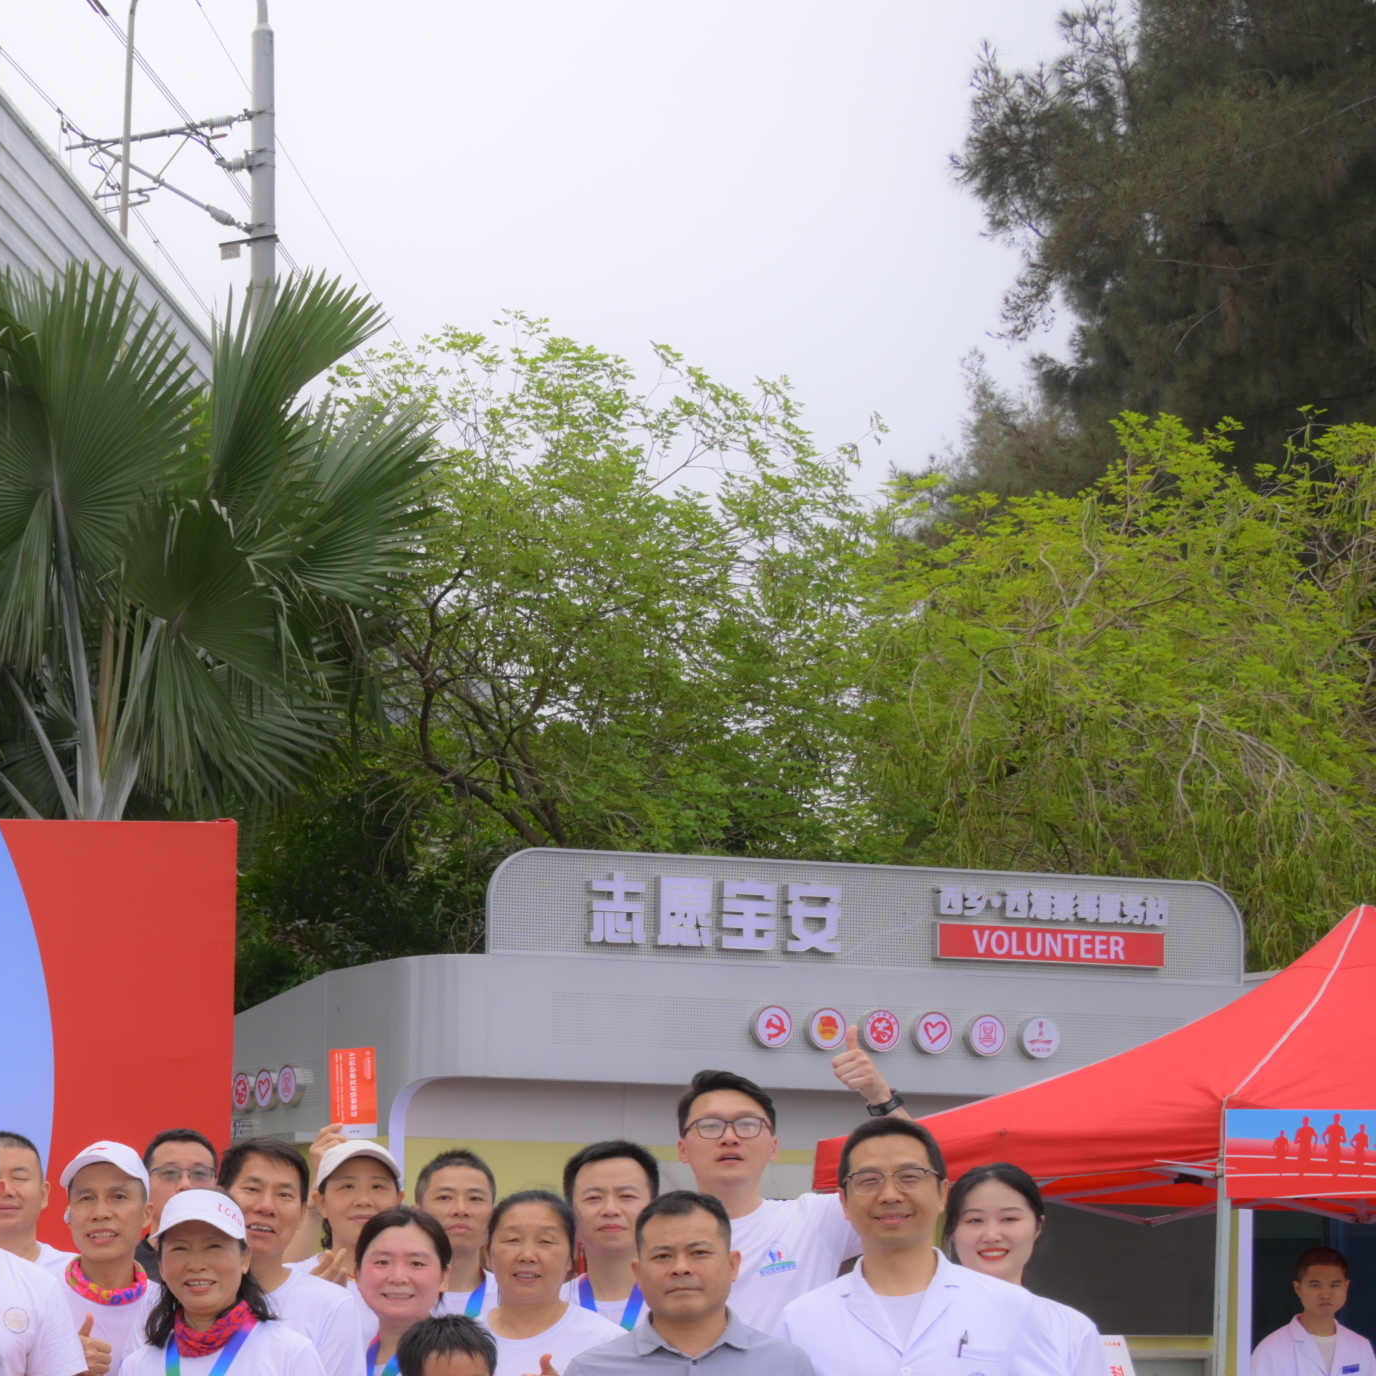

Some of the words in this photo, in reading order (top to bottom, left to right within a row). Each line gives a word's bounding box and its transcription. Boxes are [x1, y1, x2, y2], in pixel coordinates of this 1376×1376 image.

[589, 871, 842, 953] 志愿宝安
[972, 929, 1126, 961] VOLUNTEER
